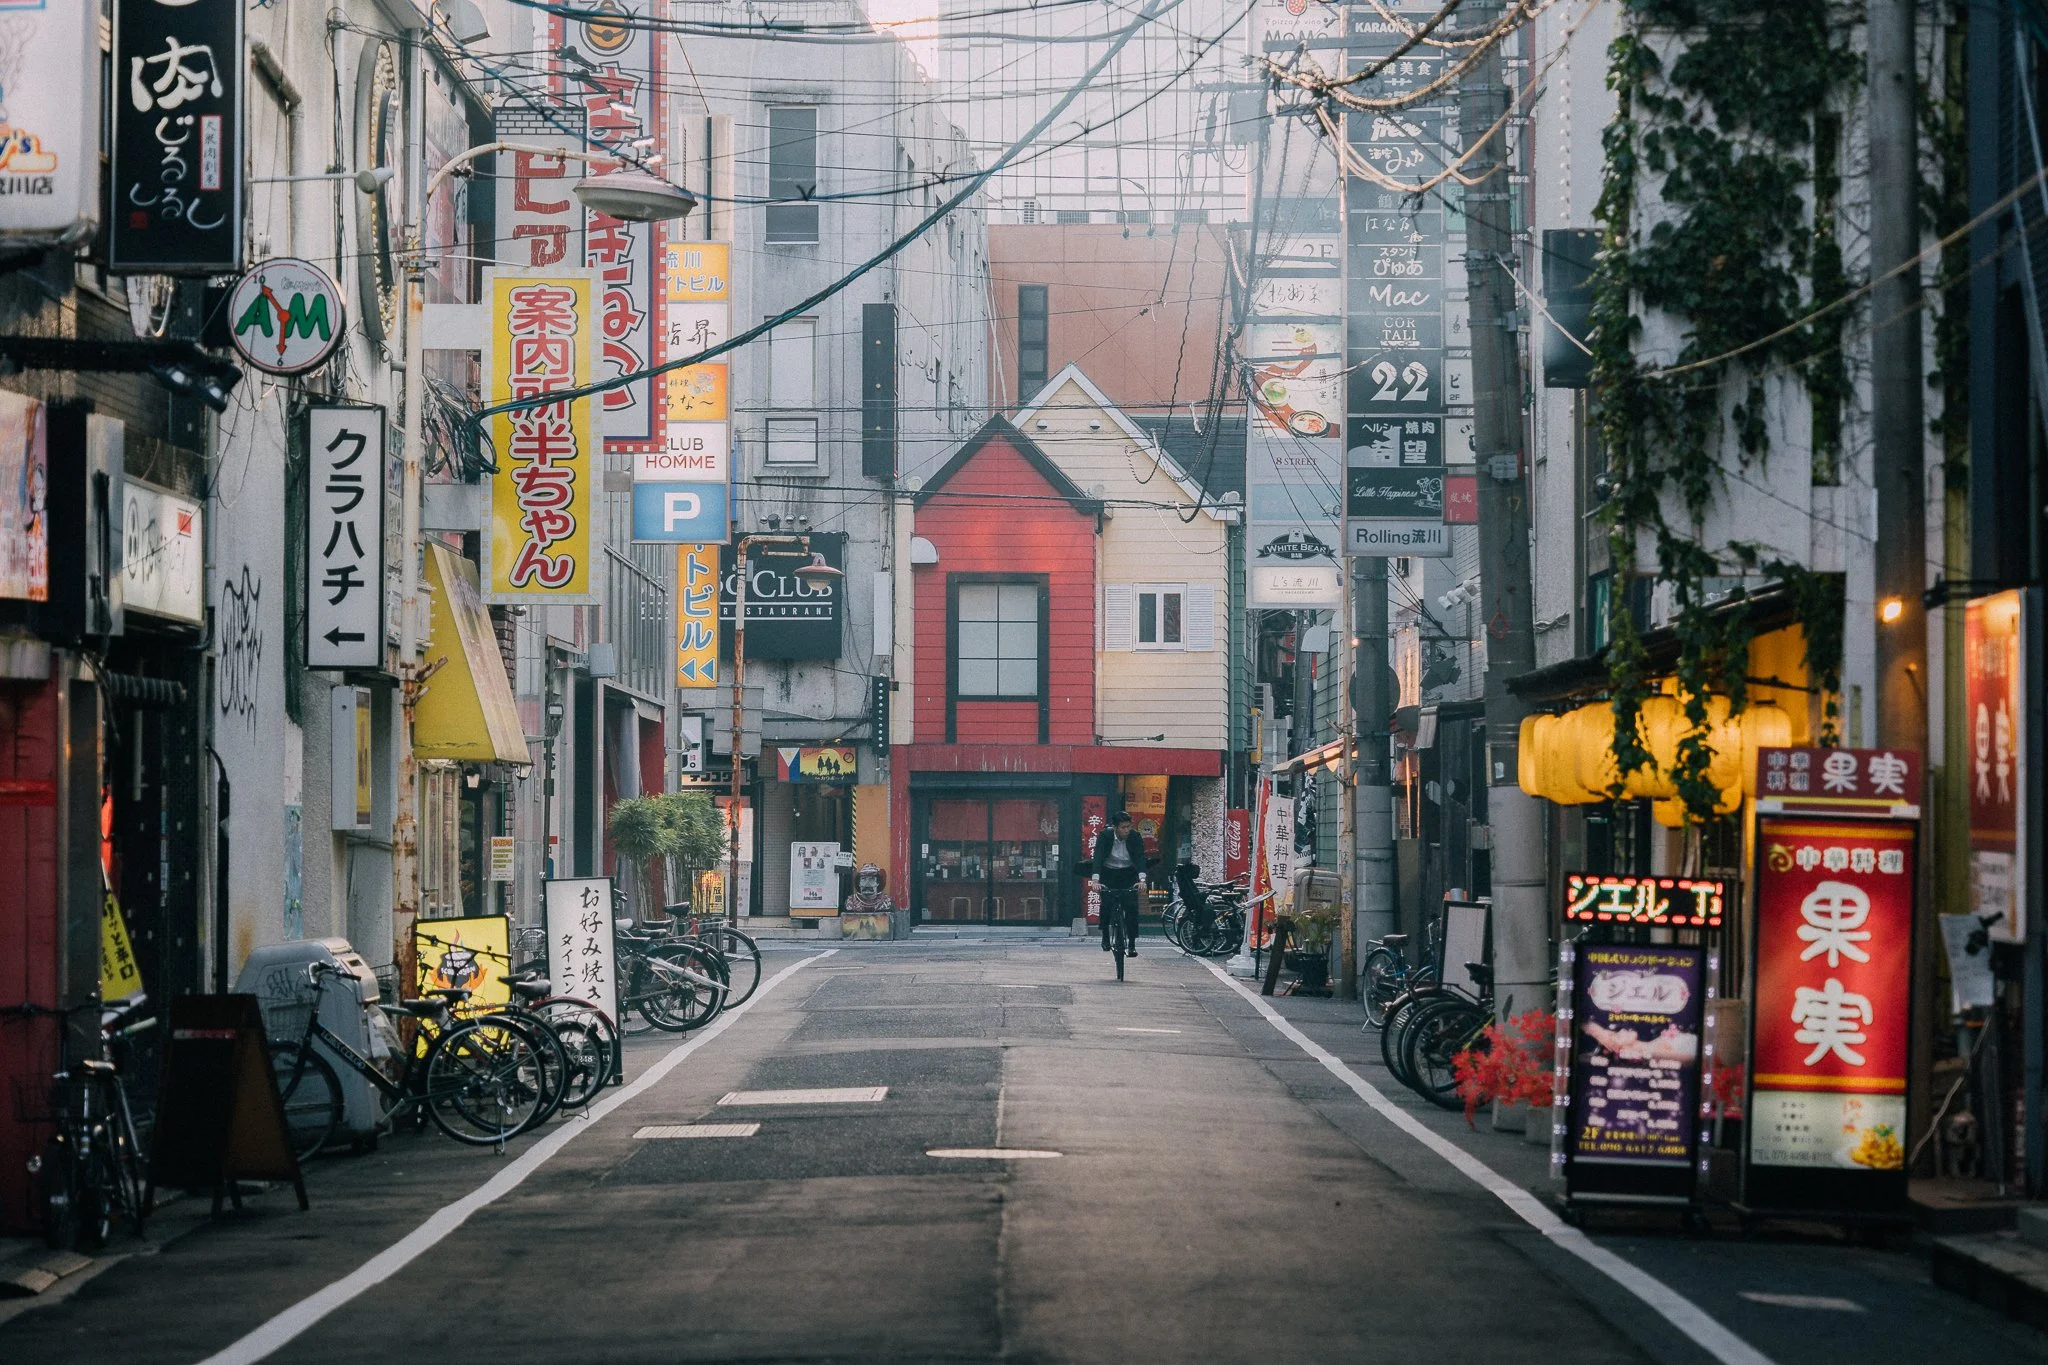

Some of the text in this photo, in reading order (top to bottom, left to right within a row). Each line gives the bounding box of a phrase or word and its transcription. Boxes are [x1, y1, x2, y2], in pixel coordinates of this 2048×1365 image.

[0, 177, 53, 195] 川店
[1380, 247, 1417, 257] スタンド
[1373, 258, 1424, 276] ぴゅあ
[1369, 283, 1430, 308] Mac
[1382, 329, 1416, 341] TALI
[1370, 361, 1429, 402] 22
[510, 285, 576, 587] 案内所半ちゃん
[1362, 421, 1435, 434] ヘルシー 焼肉
[667, 438, 704, 450] LUB
[322, 428, 367, 606] クラハチ
[664, 492, 701, 532] P
[1265, 543, 1328, 553] WHITE BEAR
[680, 544, 714, 651] トビル
[723, 607, 833, 616] RSTAURANT
[1821, 751, 1909, 795] 果実
[1271, 806, 1290, 880] 中華料理
[1796, 845, 1904, 875] 中華料理
[1790, 881, 1874, 1068] 果実
